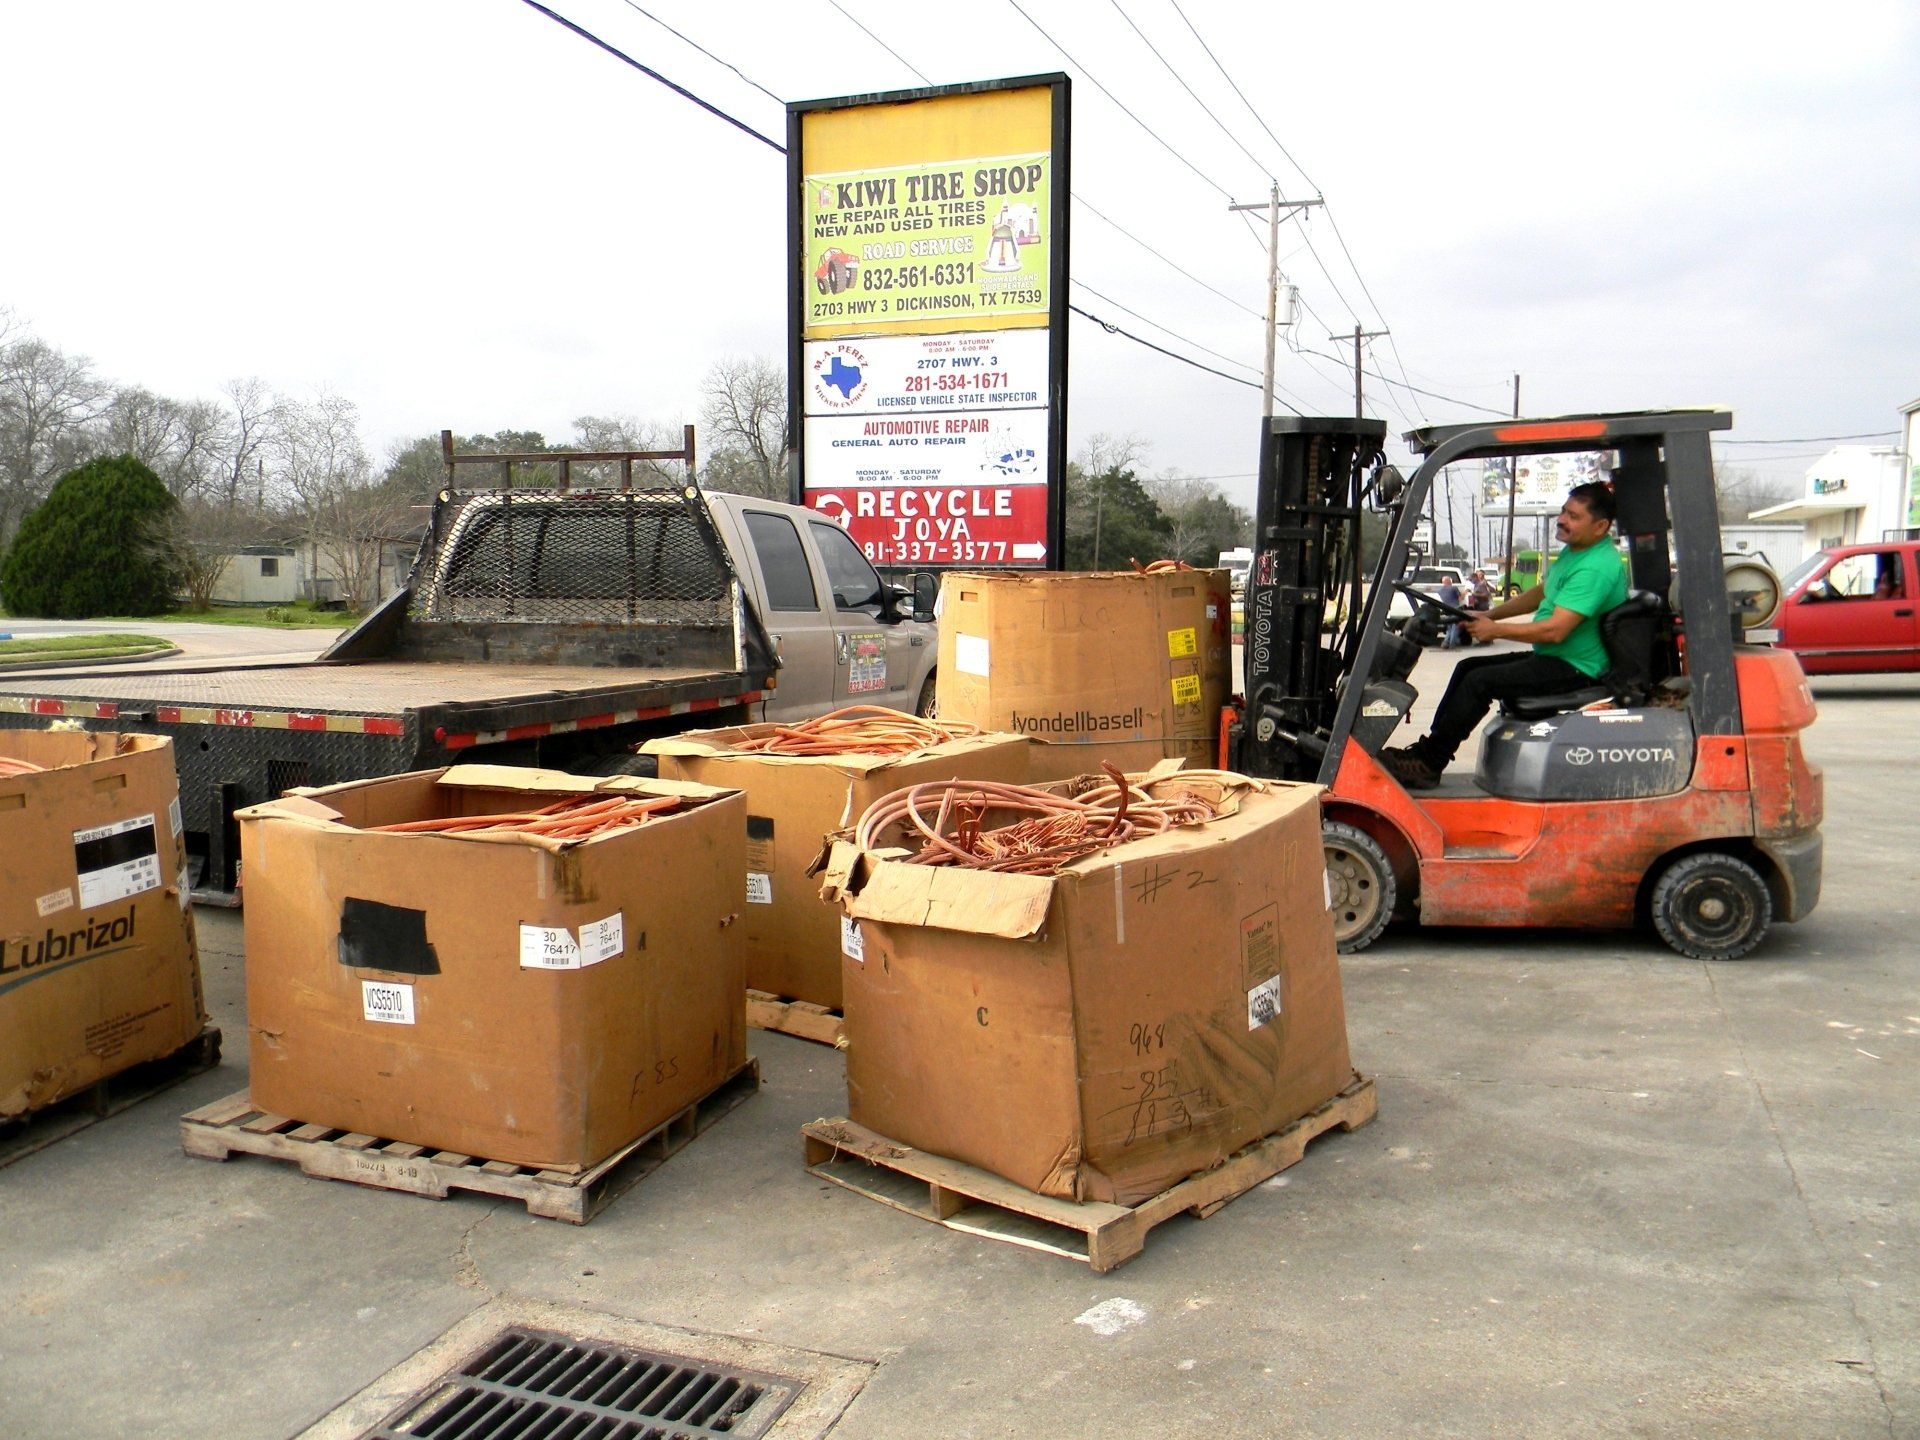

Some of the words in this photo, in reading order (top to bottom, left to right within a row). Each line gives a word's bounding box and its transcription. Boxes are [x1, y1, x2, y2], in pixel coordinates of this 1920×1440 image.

[837, 178, 896, 209] KIWI
[905, 171, 964, 202] TIRE
[974, 164, 1042, 197] SHOP
[815, 213, 838, 225] WE
[844, 208, 899, 223] REPAIR
[904, 205, 933, 218] ALL
[938, 200, 985, 214] TIRES
[815, 225, 848, 238] NEW
[853, 222, 885, 235] AND
[891, 218, 933, 231] USED
[938, 214, 986, 227] TIRES
[862, 241, 906, 261] ROAD
[910, 236, 974, 257] SERVICE
[863, 262, 974, 291] 832-561-6331
[814, 302, 843, 316] 2703
[847, 300, 877, 314] HWY
[881, 299, 888, 312] 3
[896, 294, 975, 311] DICKINSON,
[979, 292, 997, 306] TX
[1001, 289, 1042, 304] 77539
[838, 345, 868, 368] PEREZ
[917, 358, 946, 369] 2707
[952, 357, 985, 367] HWY.
[990, 356, 998, 366] 3
[905, 372, 1008, 392] 281-534-1671
[815, 384, 839, 408] STICKER
[877, 396, 917, 407] LICENSED
[920, 395, 955, 405] VEHICLE
[958, 393, 985, 403] STATE
[989, 392, 1037, 403] INSPECTOR
[863, 420, 940, 436] AUTOMOTIVE
[945, 418, 990, 434] REPAIR
[832, 439, 883, 448] GENERAL
[888, 438, 919, 446] AUTO
[924, 437, 966, 445] REPAIR
[857, 489, 1012, 518] RECYCLE
[891, 518, 971, 541] JOYA
[864, 541, 1007, 561] 81-337-3577
[1254, 589, 1273, 676] TOYOTA
[1011, 707, 1143, 734] lyondellbasell
[1597, 748, 1675, 763] TOYOTA
[0, 904, 135, 975] Lubrizol
[543, 931, 557, 943] 30
[599, 922, 608, 935] 30
[599, 929, 620, 946] 76417
[543, 943, 576, 955] 76417
[365, 988, 403, 1012] VCS5510
[1129, 1023, 1165, 1056] 968
